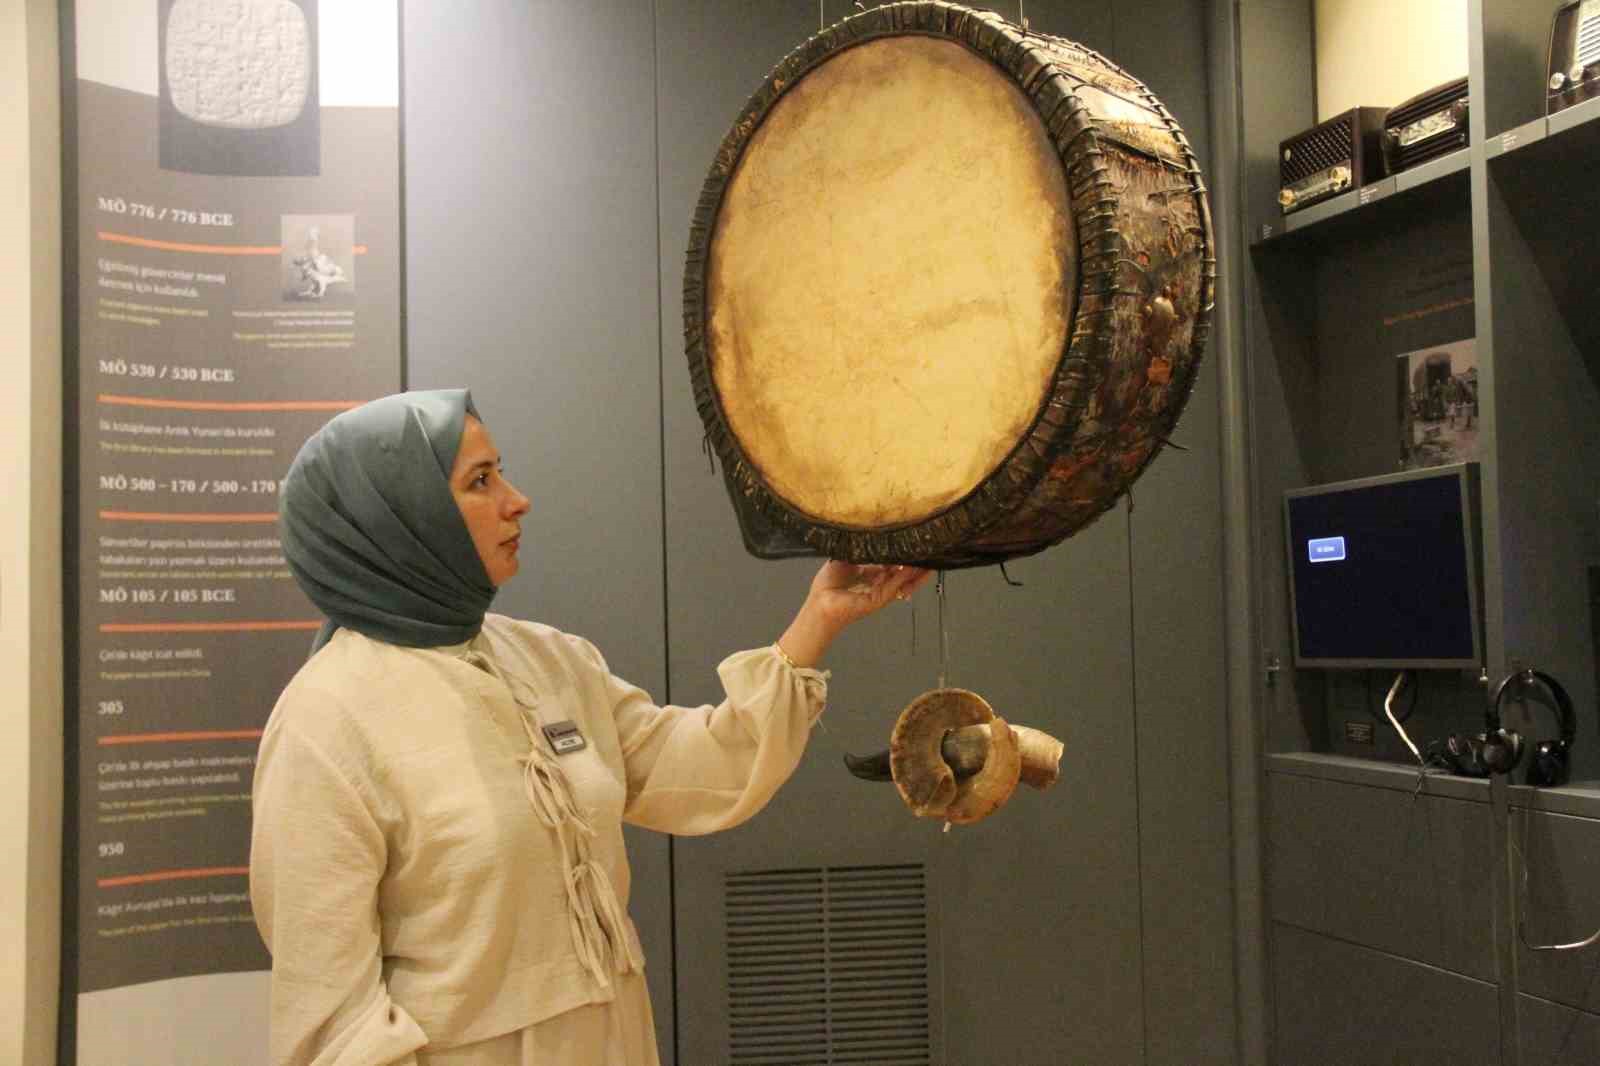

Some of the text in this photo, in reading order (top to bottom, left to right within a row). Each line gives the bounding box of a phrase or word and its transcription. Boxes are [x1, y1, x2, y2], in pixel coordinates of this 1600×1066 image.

[98, 197, 234, 226] MÖ 776 / 776 BCE
[99, 360, 235, 382] MÖ 530 / 530 BCE
[99, 475, 127, 490] MÖ
[130, 479, 156, 492] 500
[171, 480, 195, 493] 170
[199, 481, 208, 493] /
[212, 481, 238, 494] 500
[250, 480, 275, 493] 170
[100, 586, 236, 603] MÖ 105 / 105 BCE
[98, 701, 124, 715] 305
[98, 841, 125, 857] 950
